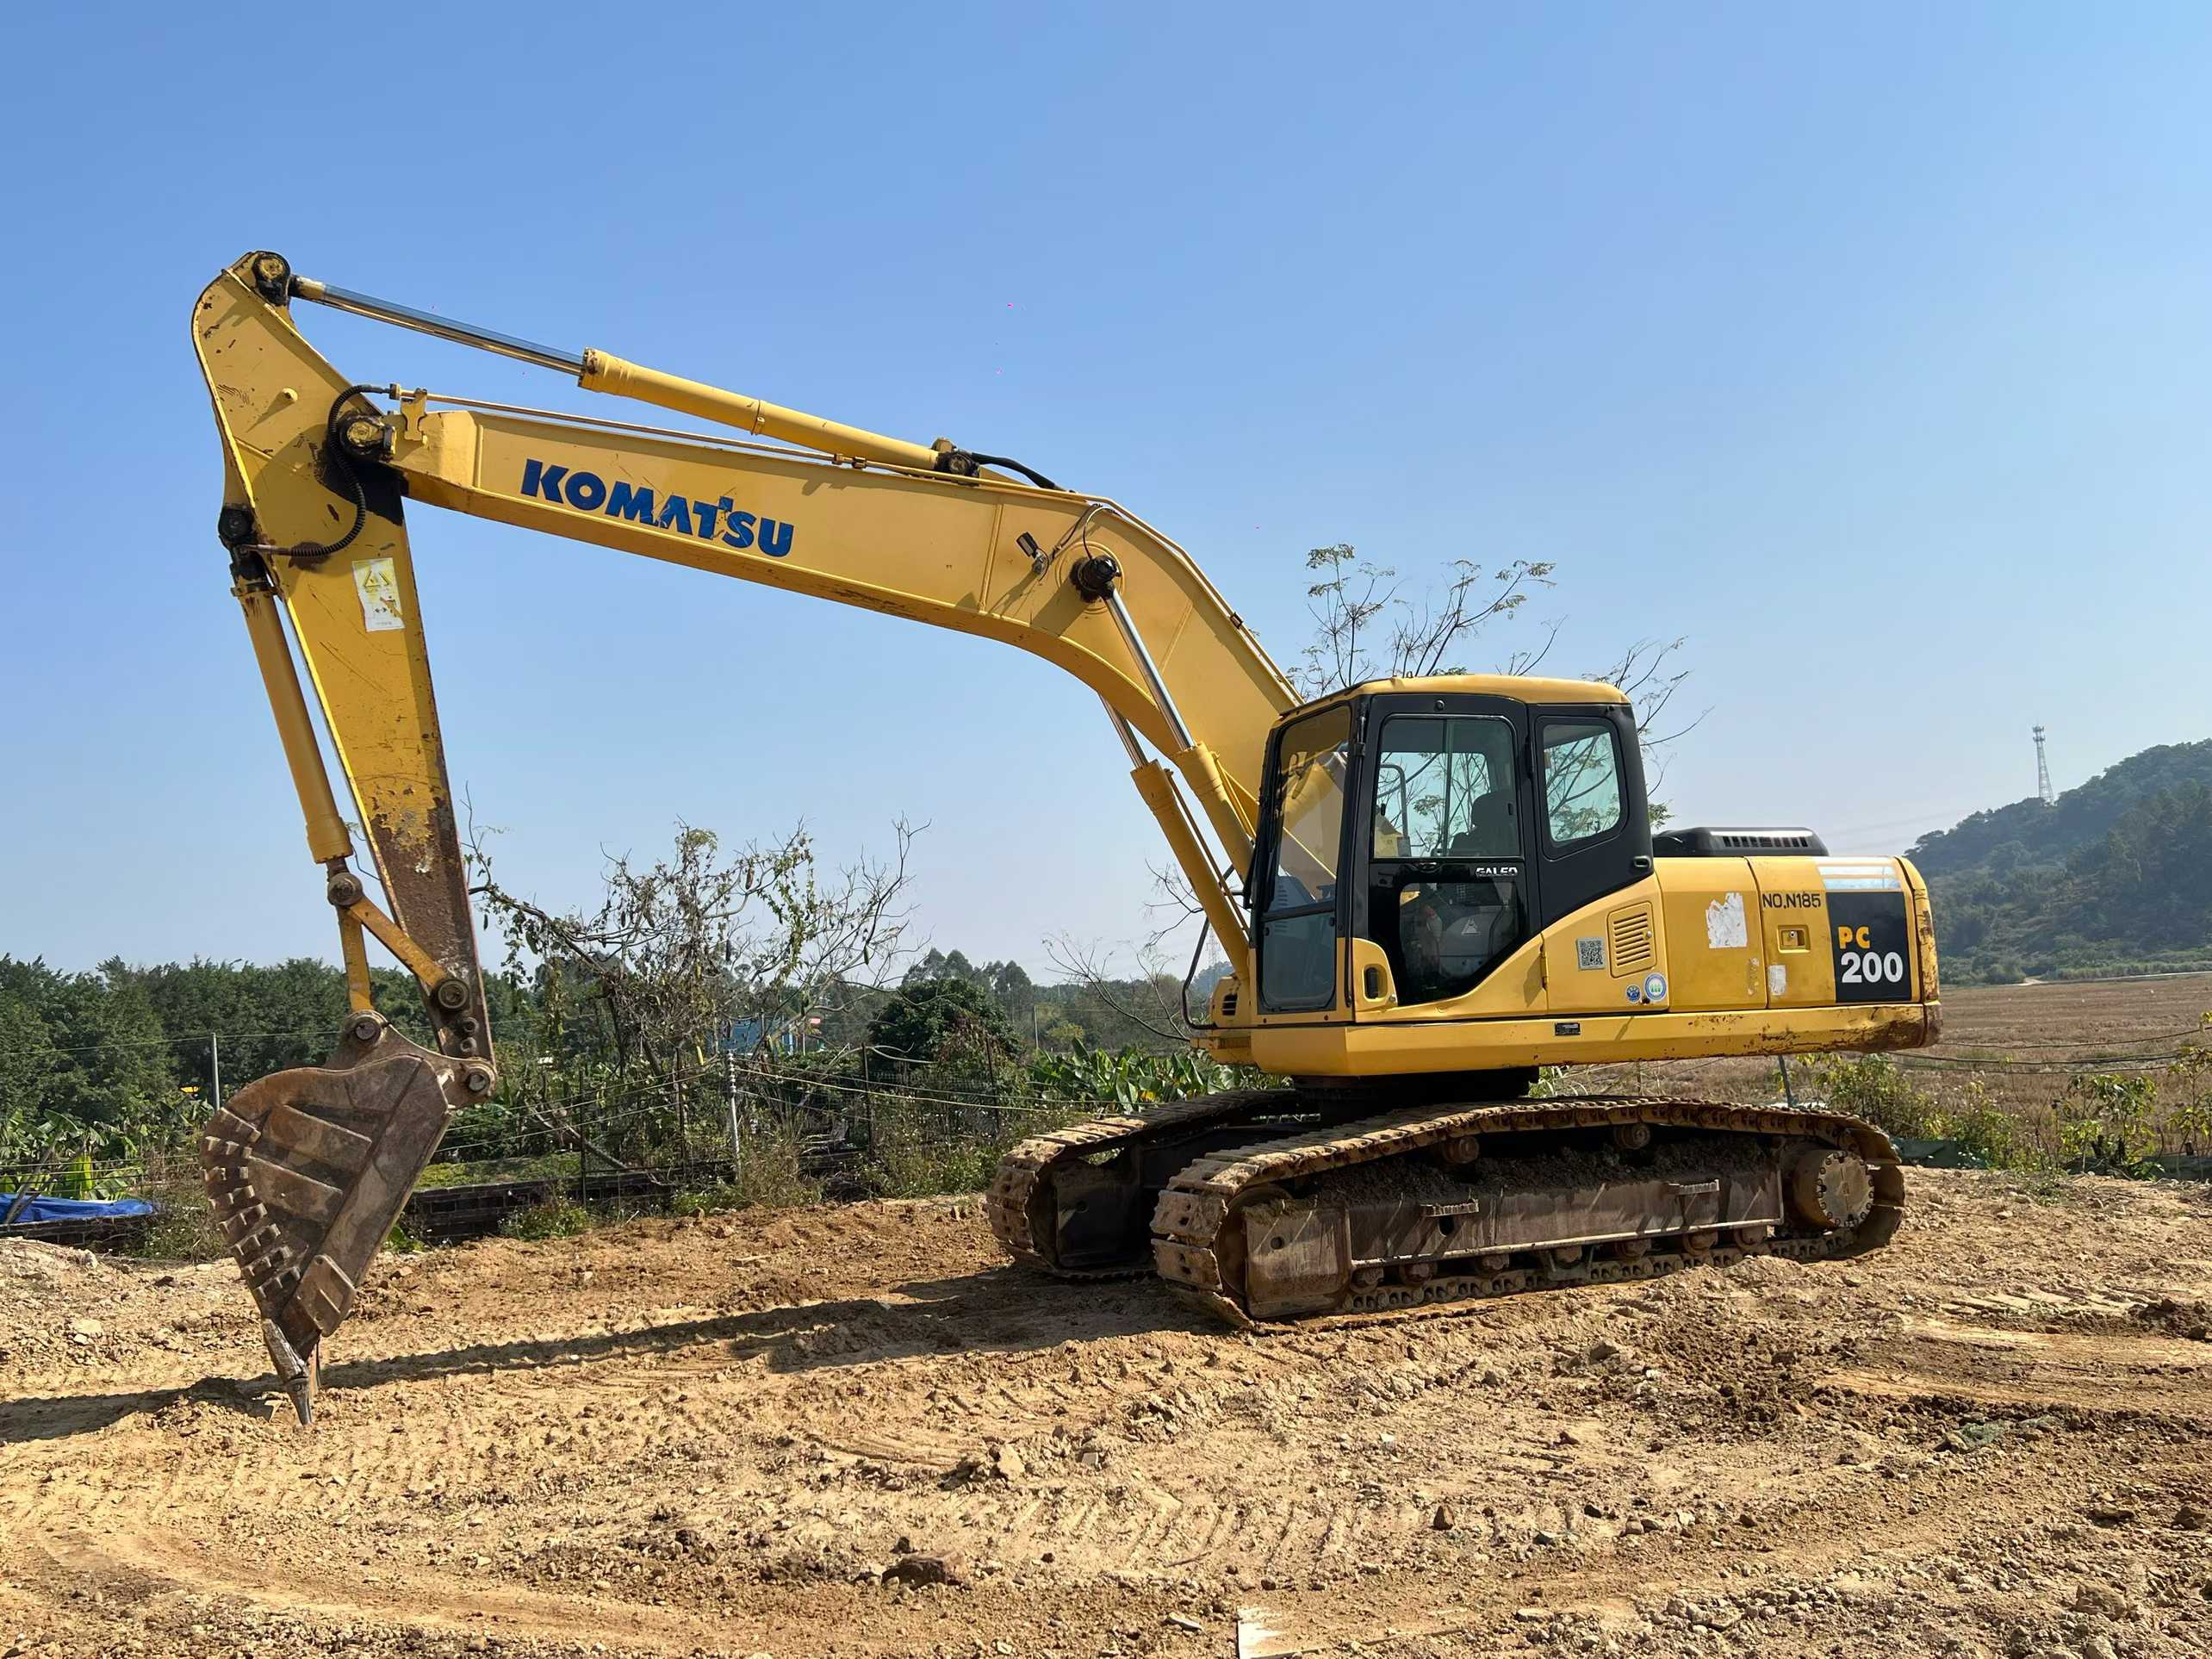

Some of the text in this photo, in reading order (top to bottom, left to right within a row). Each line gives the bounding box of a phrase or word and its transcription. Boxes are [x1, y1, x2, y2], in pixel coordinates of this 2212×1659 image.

[520, 458, 794, 557] KOMATSU
[1762, 892, 1821, 909] NO.N185
[1837, 926, 1870, 949] PC
[1841, 952, 1904, 983] 200
